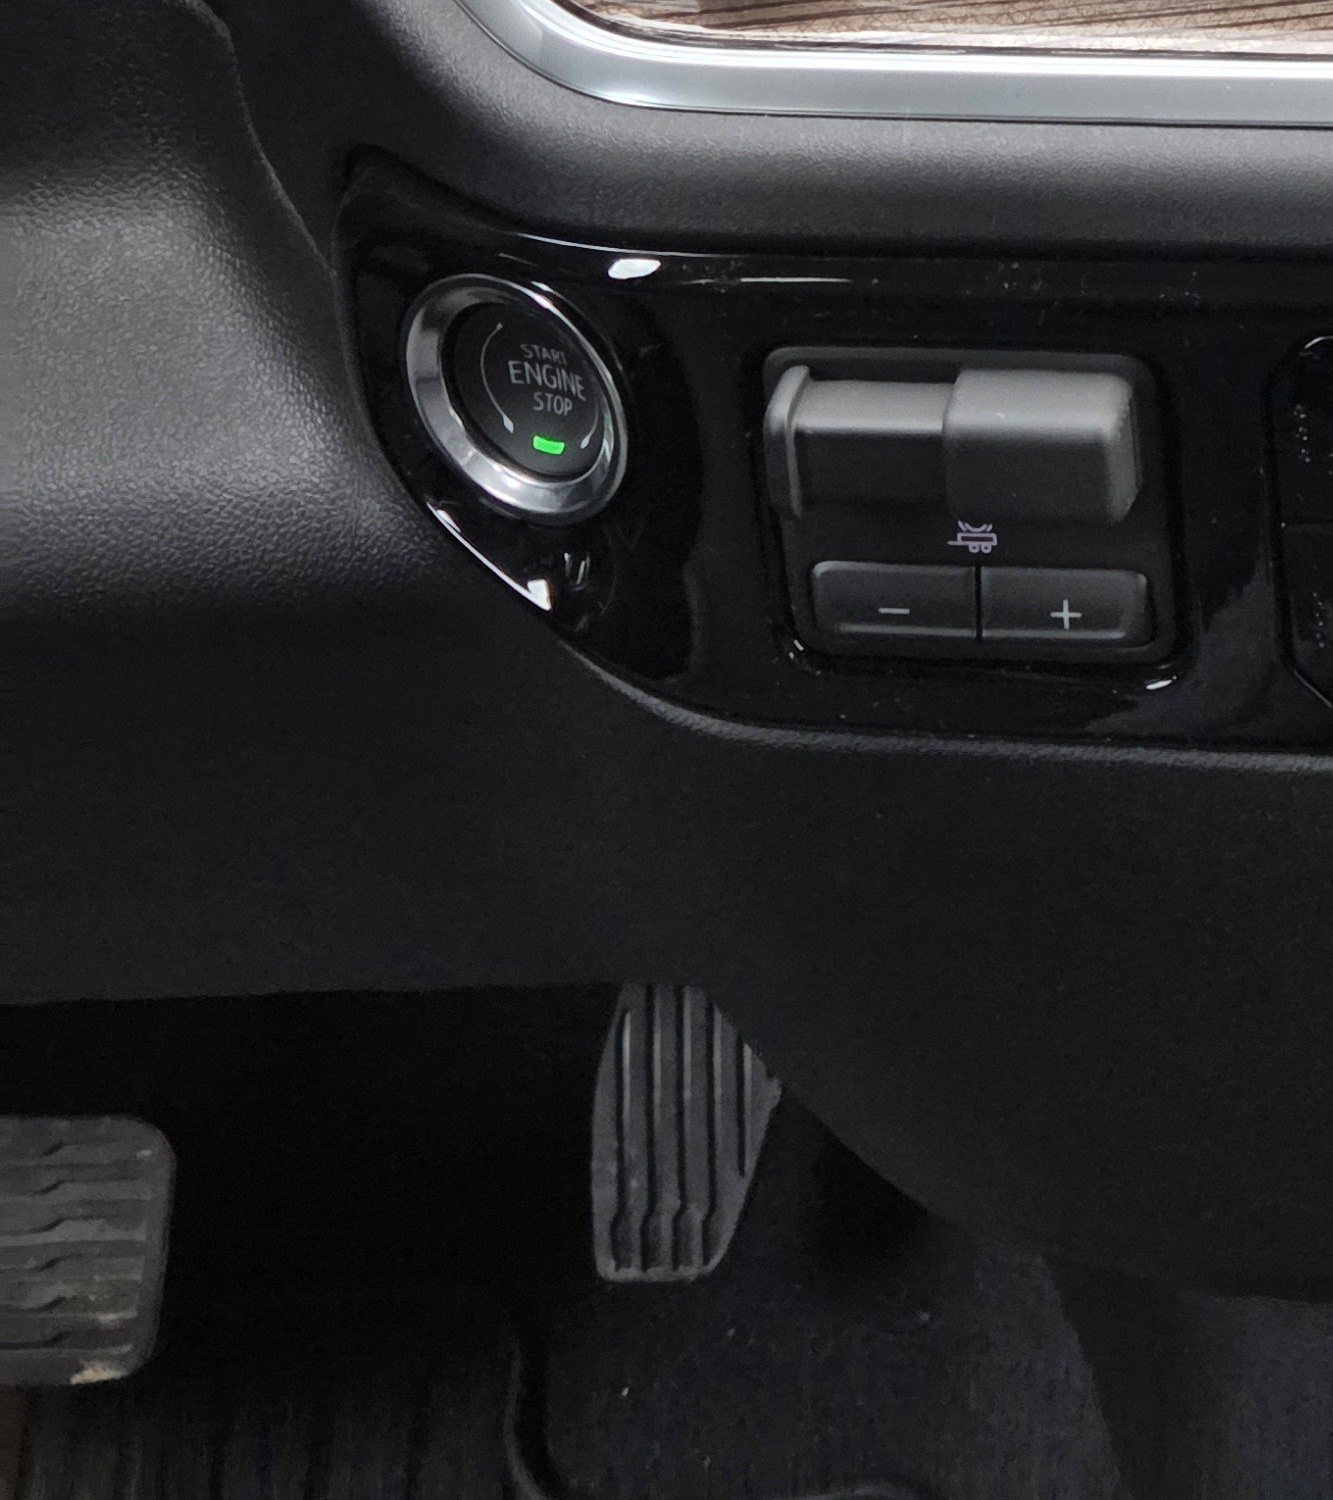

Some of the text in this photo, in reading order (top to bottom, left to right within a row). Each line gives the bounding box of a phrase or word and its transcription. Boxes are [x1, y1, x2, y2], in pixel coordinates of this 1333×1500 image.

[520, 343, 568, 365] START
[508, 360, 586, 400] ENGINE
[532, 391, 573, 416] STOP
